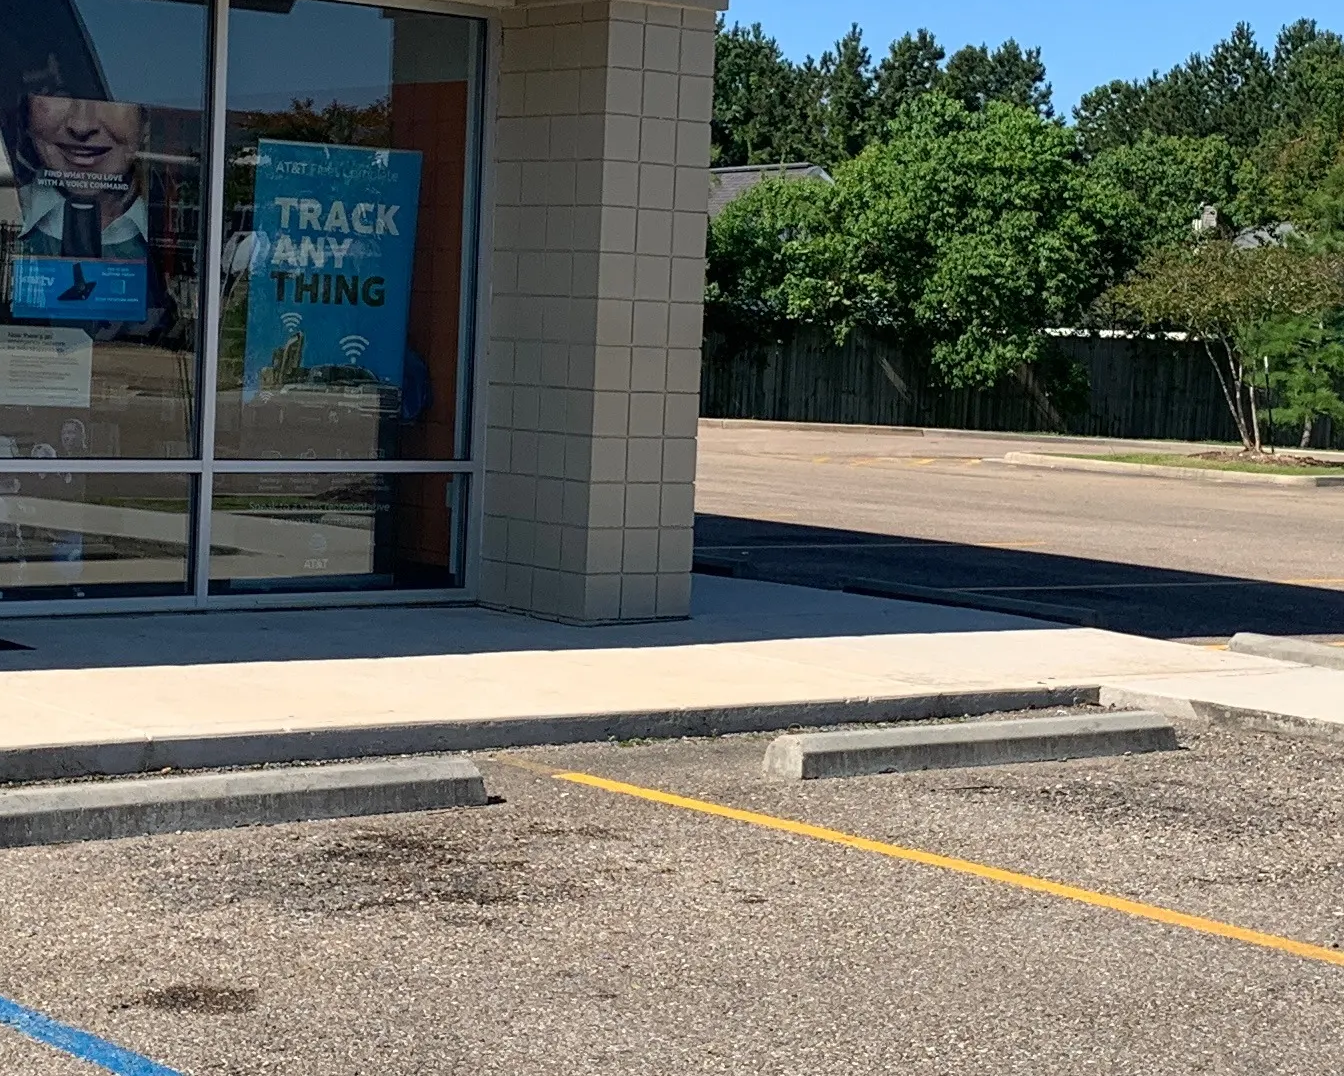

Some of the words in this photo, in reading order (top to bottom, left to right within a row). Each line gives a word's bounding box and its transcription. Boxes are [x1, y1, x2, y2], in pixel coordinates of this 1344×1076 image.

[44, 170, 62, 178] FIND
[63, 171, 85, 179] WHAT
[86, 172, 103, 180] YOU
[104, 173, 123, 181] LOVE
[275, 161, 308, 175] AT&T
[38, 178, 57, 186] WITH
[58, 179, 65, 187] A
[66, 180, 88, 188] VOICE
[89, 182, 129, 190] COMMAND
[274, 197, 400, 237] TRACK
[271, 236, 354, 269] ANY
[270, 272, 387, 308] THING
